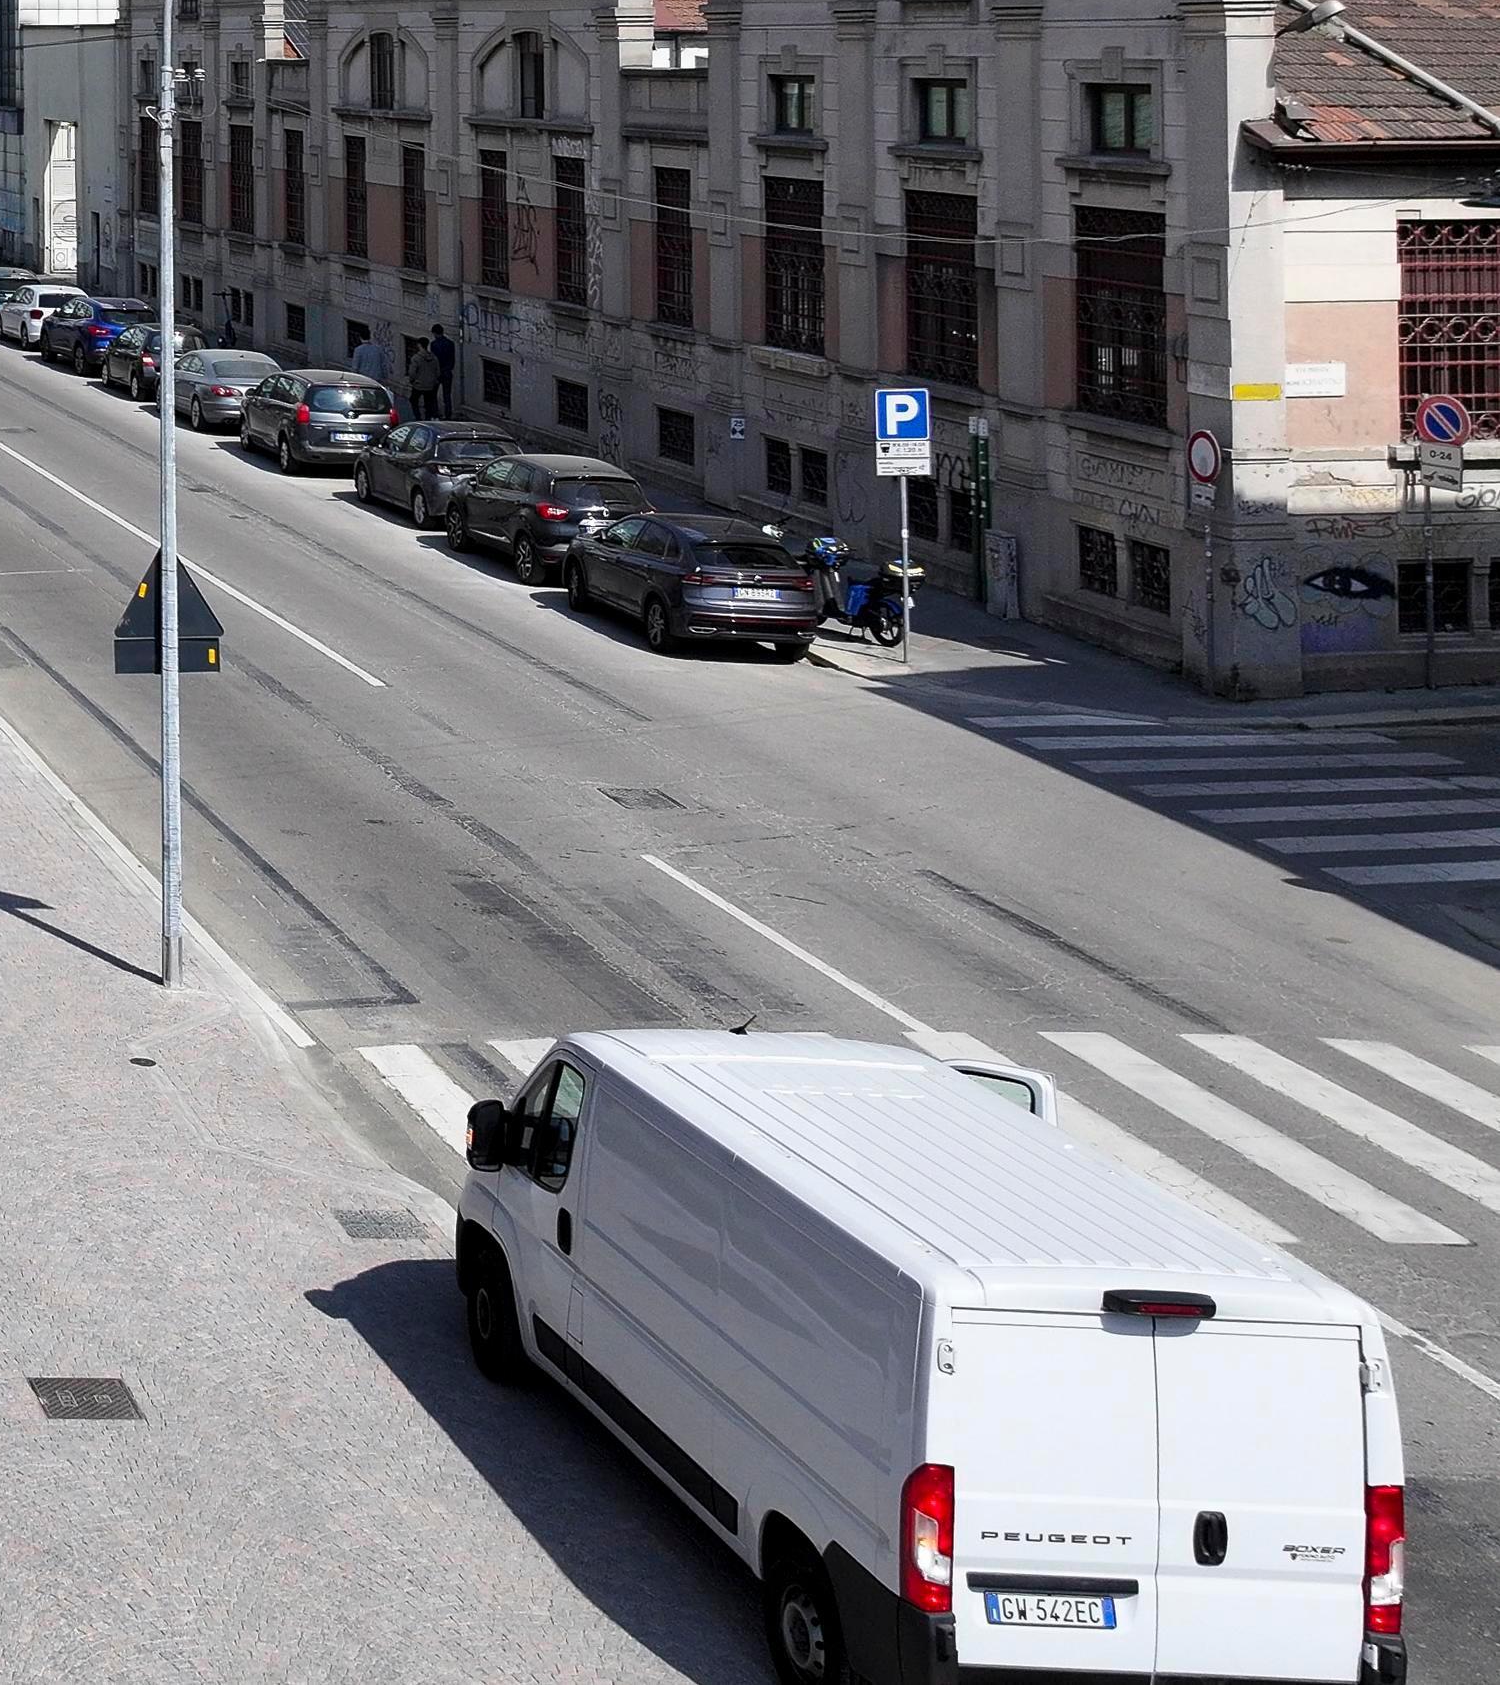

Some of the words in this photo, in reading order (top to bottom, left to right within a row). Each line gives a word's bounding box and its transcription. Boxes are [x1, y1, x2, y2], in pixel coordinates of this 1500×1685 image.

[886, 394, 919, 436] P
[1429, 450, 1453, 461] 0-24
[980, 1531, 1133, 1546] PEUGEOT
[1282, 1544, 1347, 1555] BOXER
